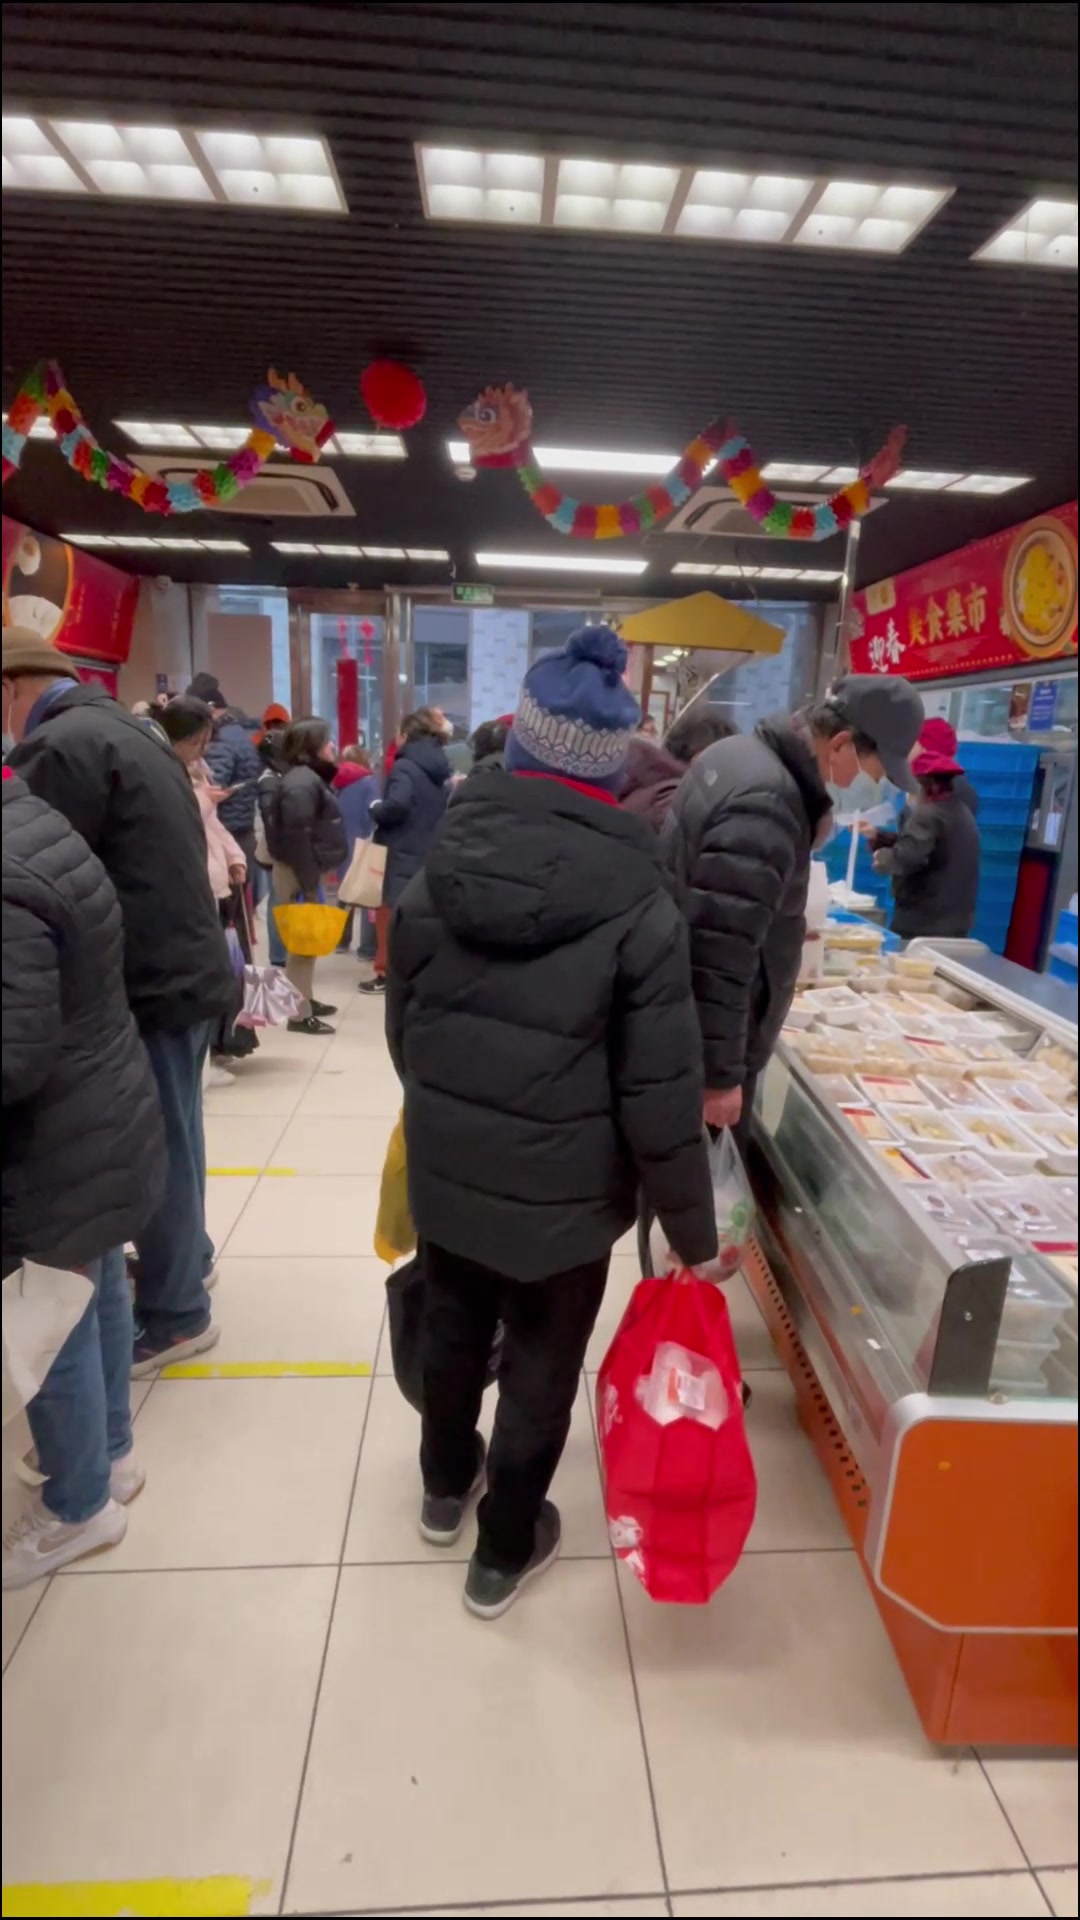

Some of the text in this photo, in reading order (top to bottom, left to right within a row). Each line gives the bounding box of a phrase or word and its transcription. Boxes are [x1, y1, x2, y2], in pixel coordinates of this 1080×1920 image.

[868, 617, 906, 673] 迎春
[908, 582, 988, 648] 美食集市
